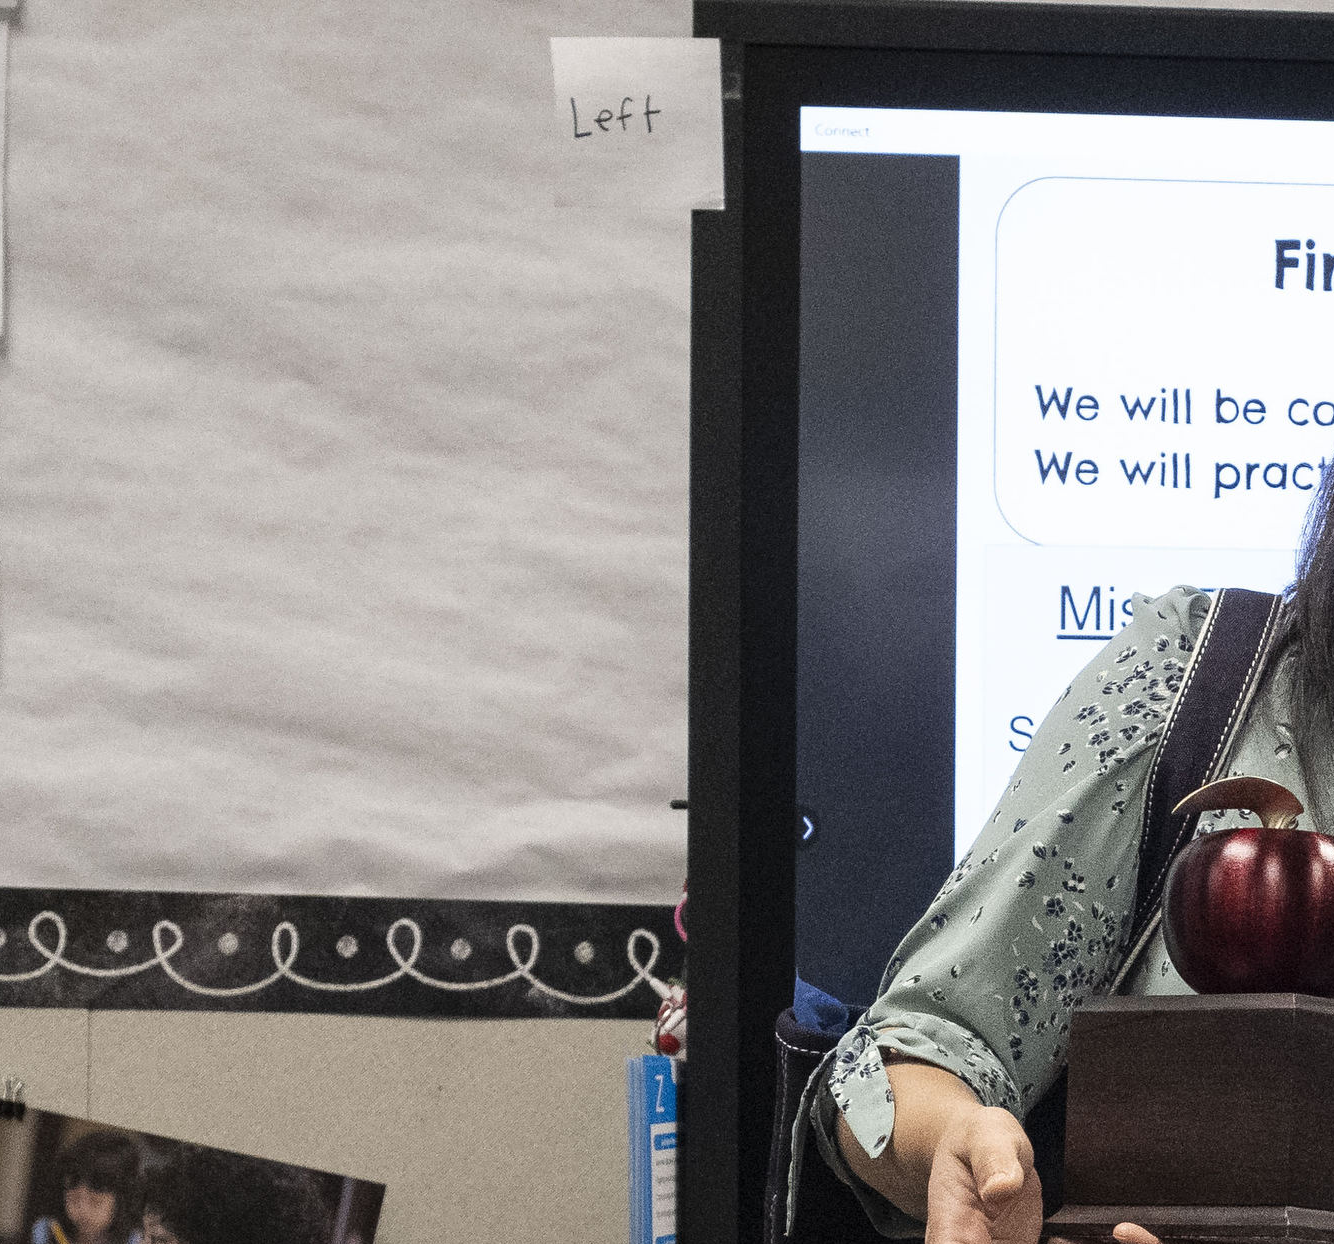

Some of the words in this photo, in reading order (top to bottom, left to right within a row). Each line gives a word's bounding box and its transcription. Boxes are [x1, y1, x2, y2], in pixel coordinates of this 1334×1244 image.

[570, 95, 661, 137] Left
[1035, 385, 1098, 422] We
[1121, 386, 1193, 424] will
[1214, 388, 1268, 427] be
[1035, 450, 1098, 486] We
[1121, 452, 1193, 490] will
